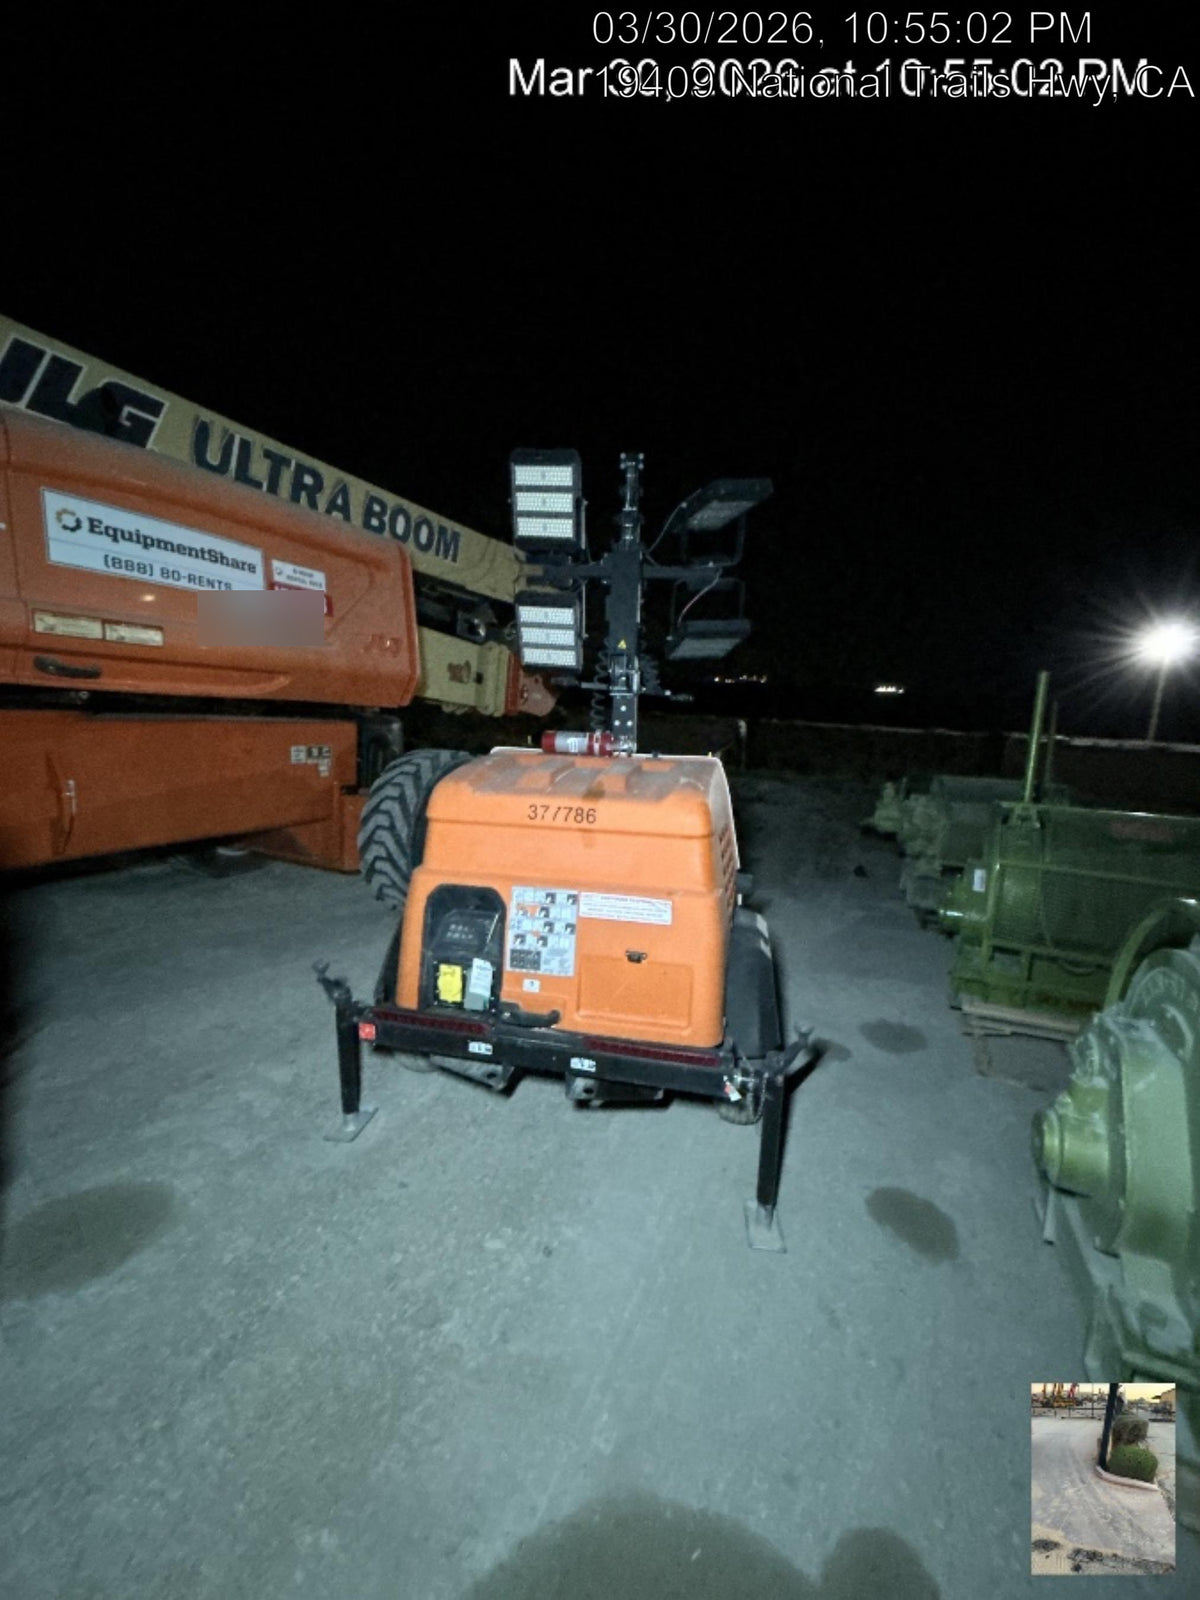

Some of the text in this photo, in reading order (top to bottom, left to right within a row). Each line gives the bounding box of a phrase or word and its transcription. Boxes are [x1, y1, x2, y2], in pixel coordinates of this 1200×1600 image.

[193, 414, 461, 563] ULTRA BOOM
[86, 516, 257, 574] EquipmentShare
[103, 554, 154, 577] (888)
